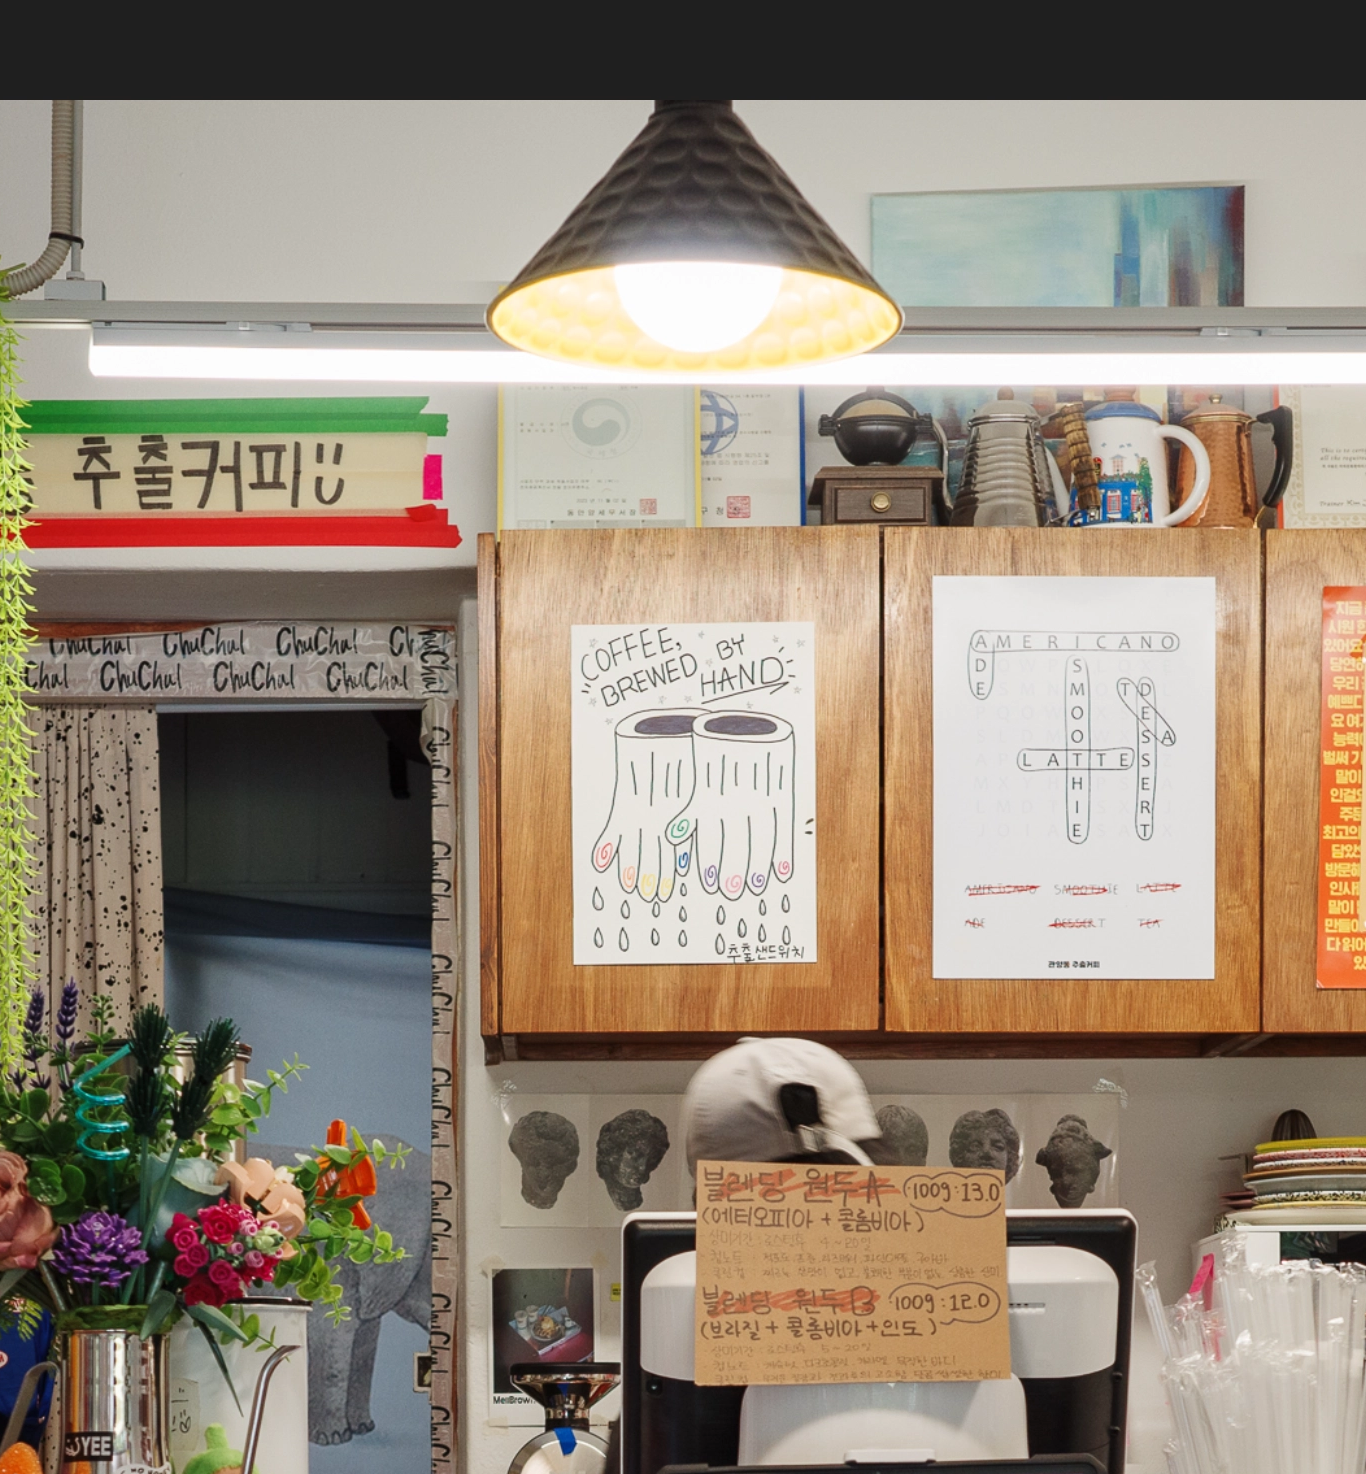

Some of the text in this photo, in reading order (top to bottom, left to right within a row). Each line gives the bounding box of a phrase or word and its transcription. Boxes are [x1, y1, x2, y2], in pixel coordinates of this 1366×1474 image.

[73, 434, 302, 512] 추출커피
[1335, 601, 1363, 616] 지금
[974, 634, 1176, 650] AMERICANO
[1327, 619, 1355, 635] 시원
[600, 633, 745, 707] BREWED BY
[700, 656, 785, 698] HAND
[1022, 753, 1129, 768] LATTE
[1069, 657, 1086, 839] SMOOTHIE
[1139, 682, 1153, 839] DESSERT
[1326, 937, 1341, 952] 다
[703, 1166, 786, 1203] 블렌딩
[702, 1284, 772, 1316] 블렌딩
[786, 1317, 862, 1340] 콜롬비아
